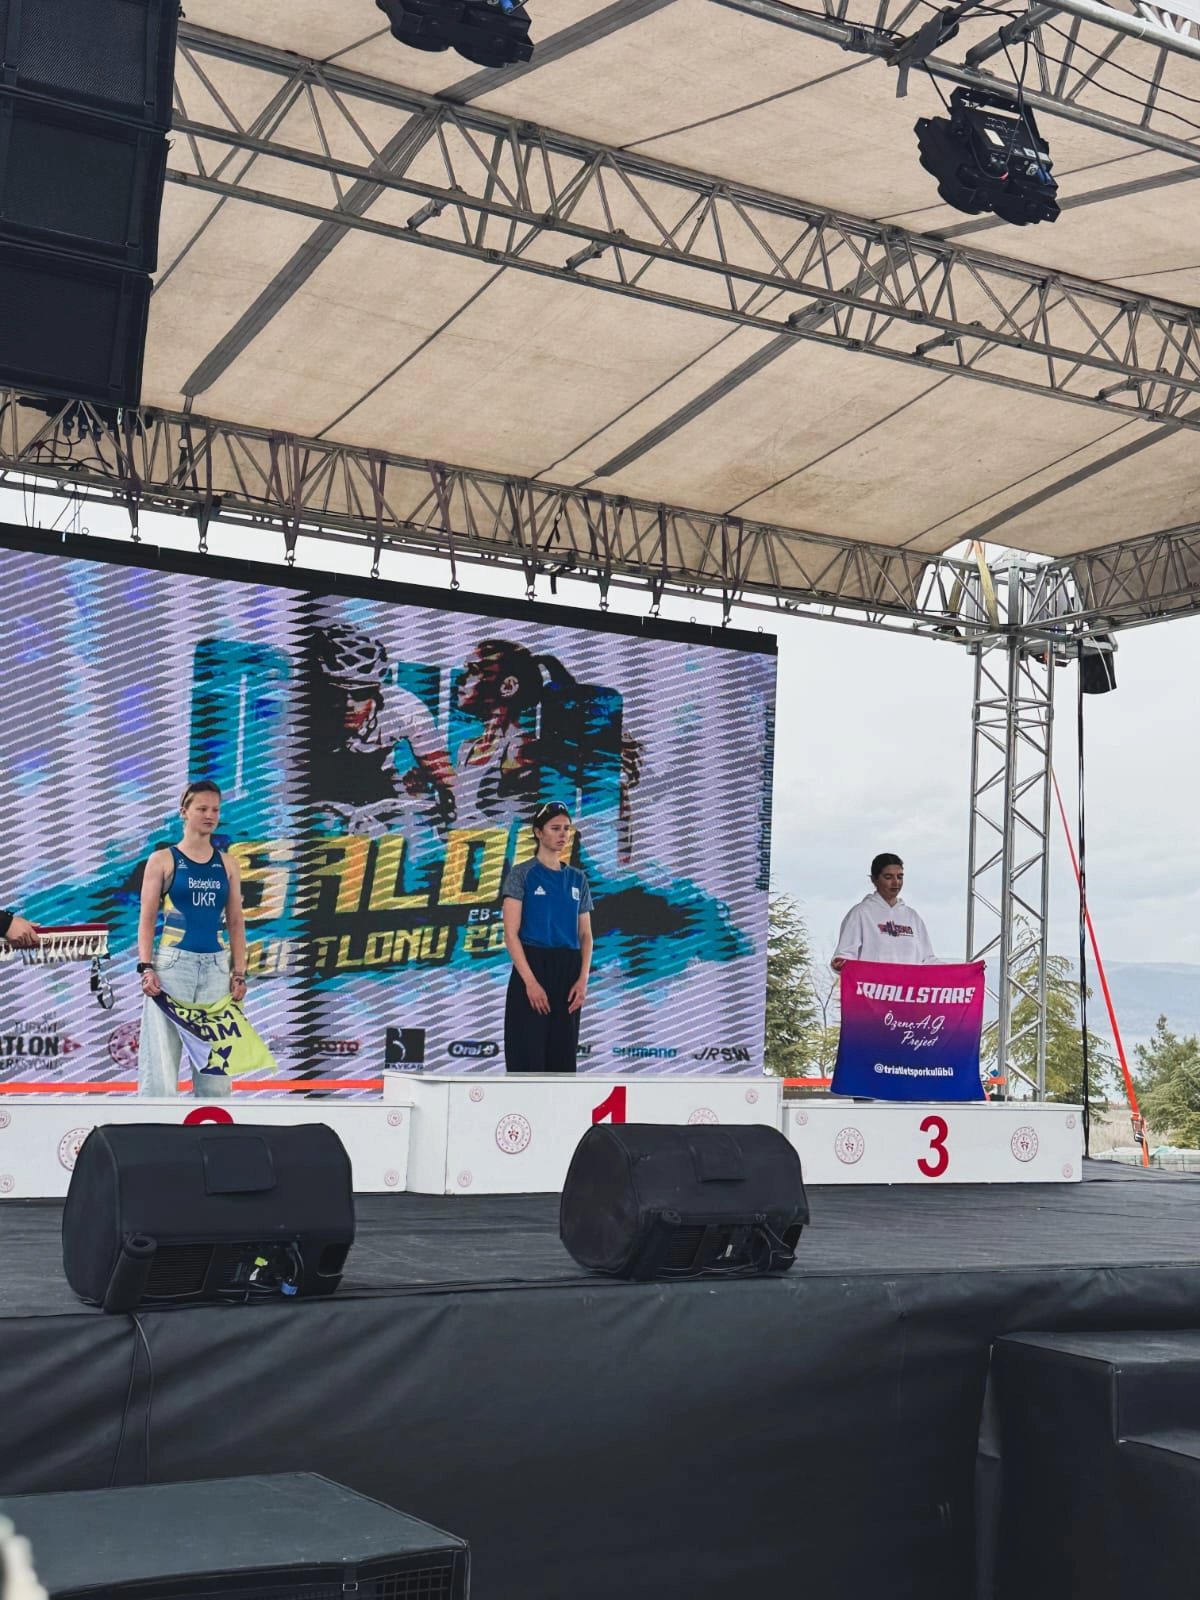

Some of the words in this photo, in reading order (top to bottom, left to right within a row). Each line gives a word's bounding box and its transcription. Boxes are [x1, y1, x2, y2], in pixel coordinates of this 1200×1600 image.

[192, 891, 216, 907] UKR
[856, 981, 976, 1004] TRIALLSTARS
[900, 1030, 939, 1051] Project
[612, 1047, 677, 1058] SHIMANO
[917, 1115, 949, 1178] 3
